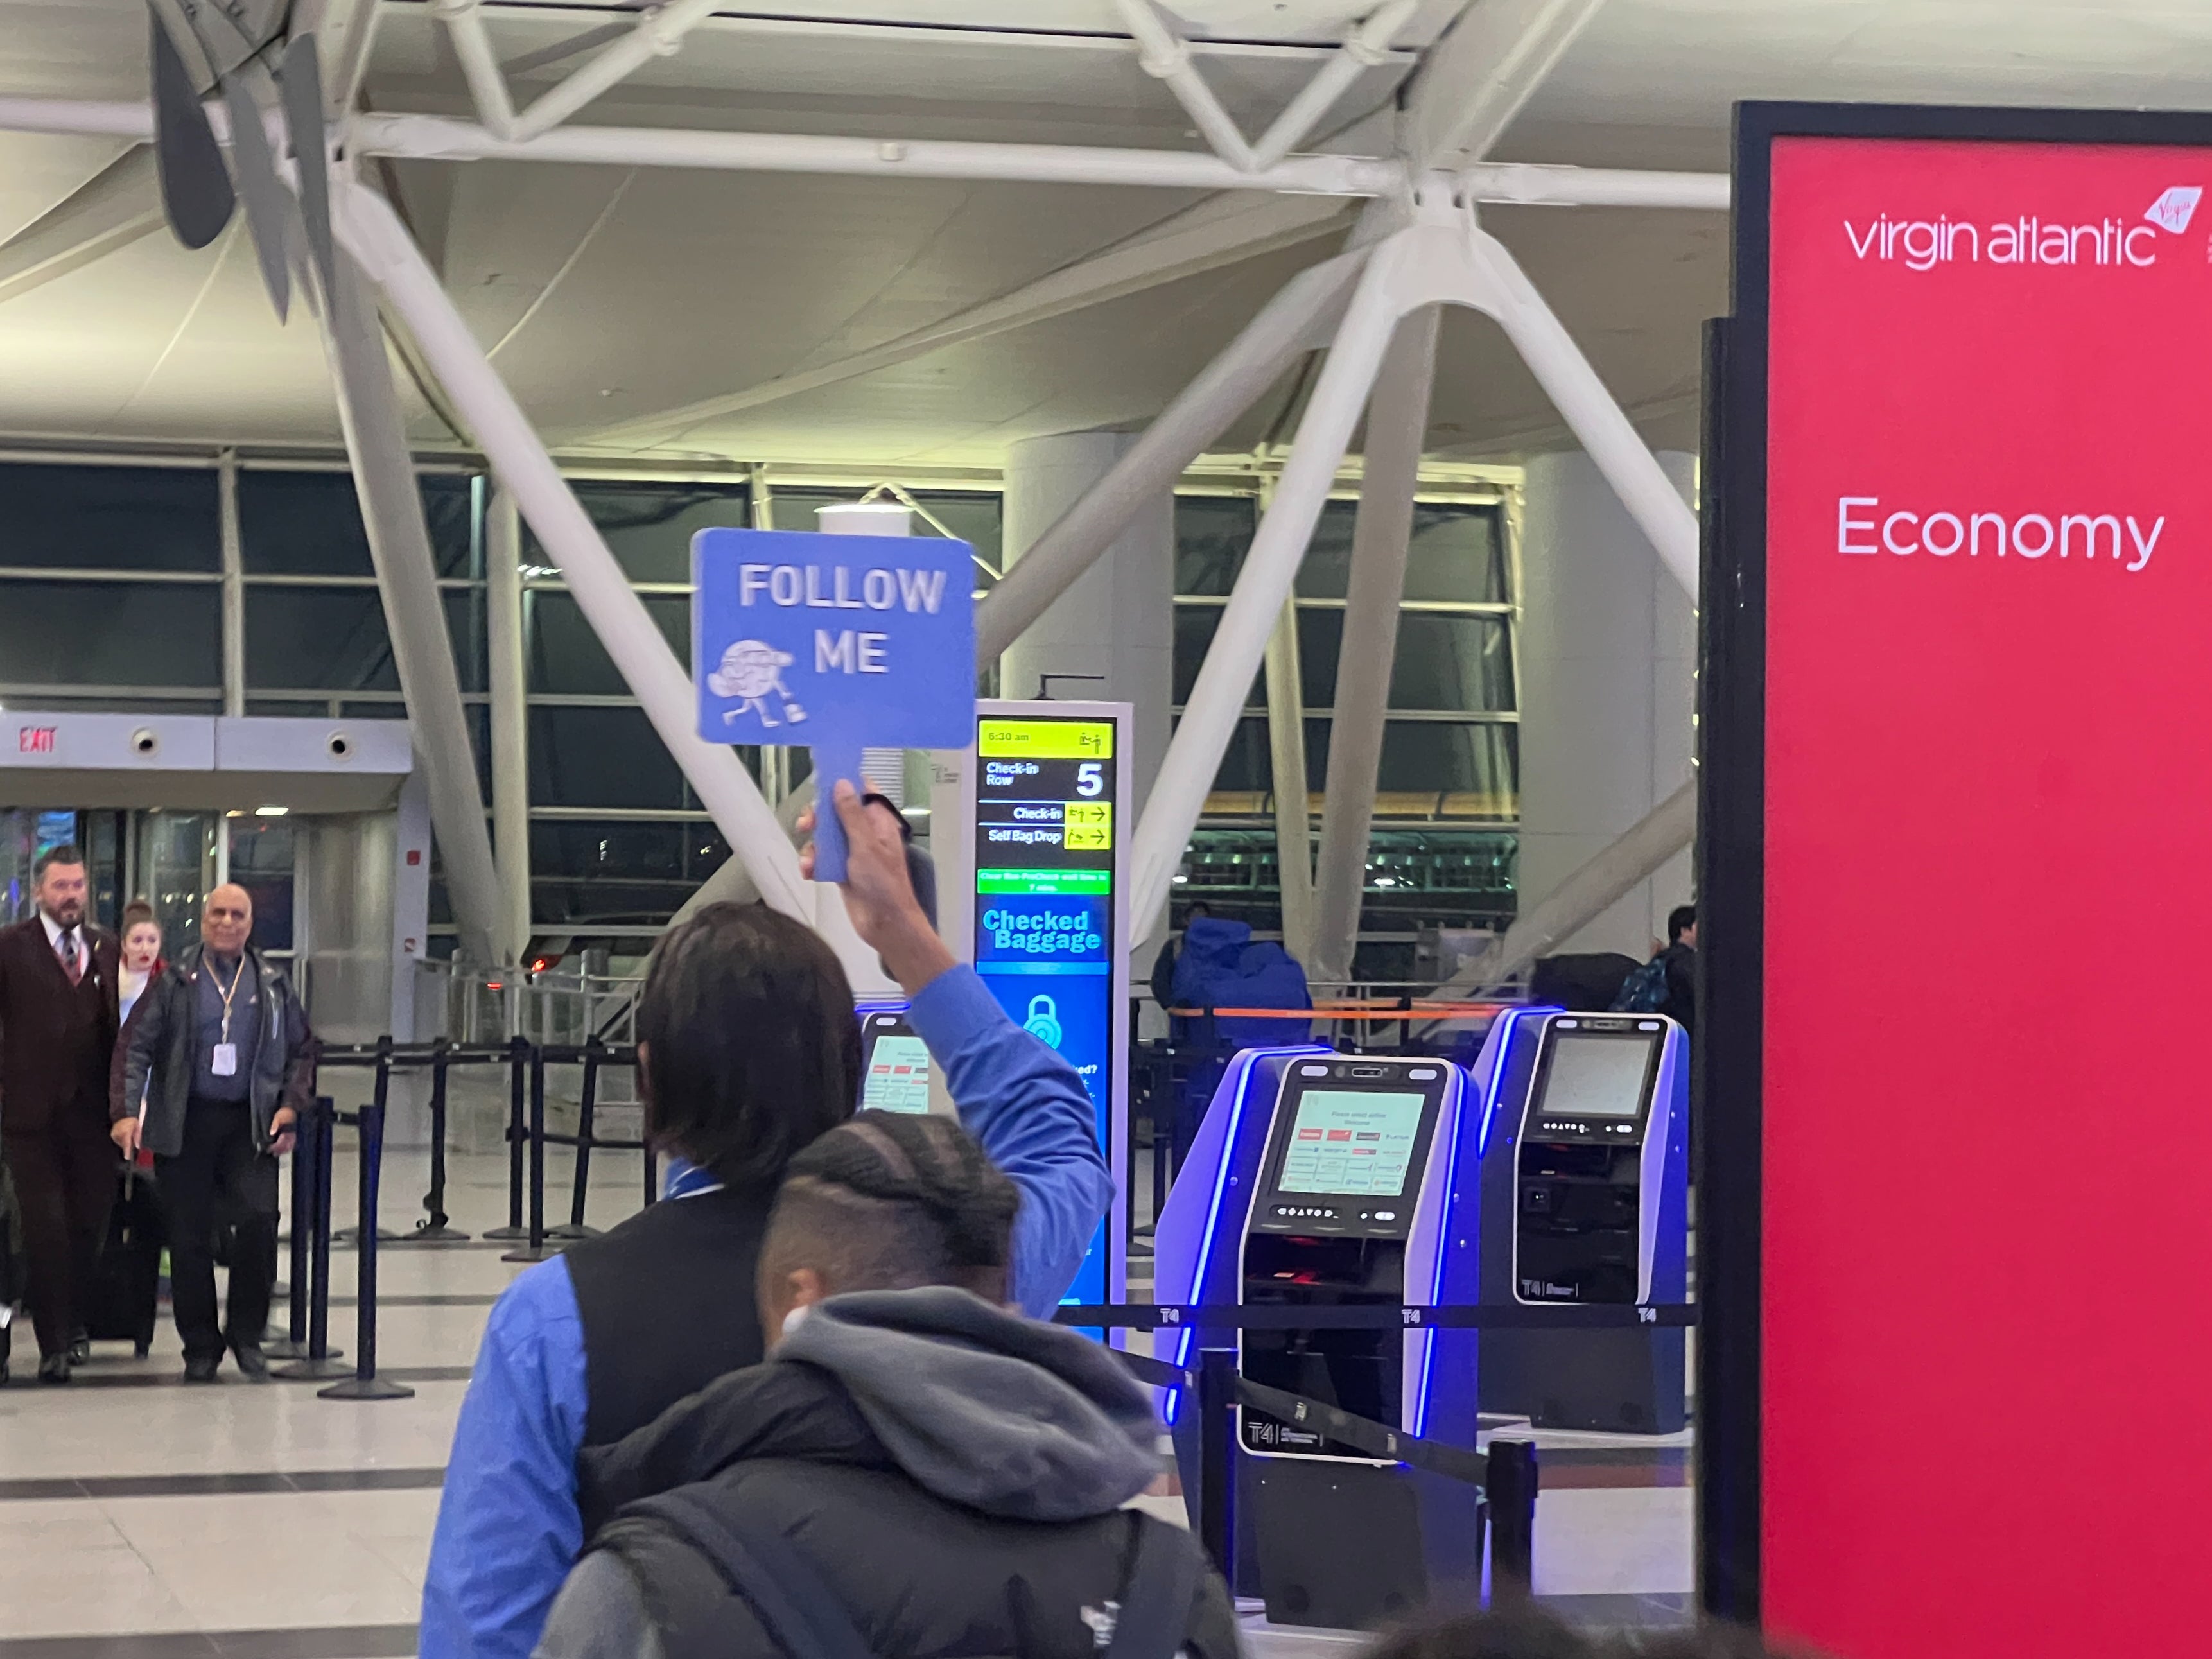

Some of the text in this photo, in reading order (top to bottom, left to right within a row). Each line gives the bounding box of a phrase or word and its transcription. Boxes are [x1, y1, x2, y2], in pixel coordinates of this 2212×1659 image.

[1844, 213, 1978, 271] virgin
[1988, 216, 2156, 266] atlantic
[1838, 496, 2164, 571] Economy
[740, 563, 946, 614] FOLLOW
[815, 629, 889, 674] ME
[20, 726, 57, 752] EXIT
[988, 732, 1012, 740] 6:30
[986, 761, 1039, 774] Check-in
[986, 774, 1014, 785] Row
[1076, 763, 1104, 797] 5
[1013, 807, 1063, 819] Check-in
[988, 829, 1062, 844] Self Bag Drop
[983, 910, 1088, 930] Checked
[995, 929, 1101, 953] Baggage
[1160, 1308, 1179, 1323] T4
[1402, 1308, 1420, 1323] T4
[1638, 1307, 1656, 1323] T4
[1248, 1421, 1273, 1444] T4
